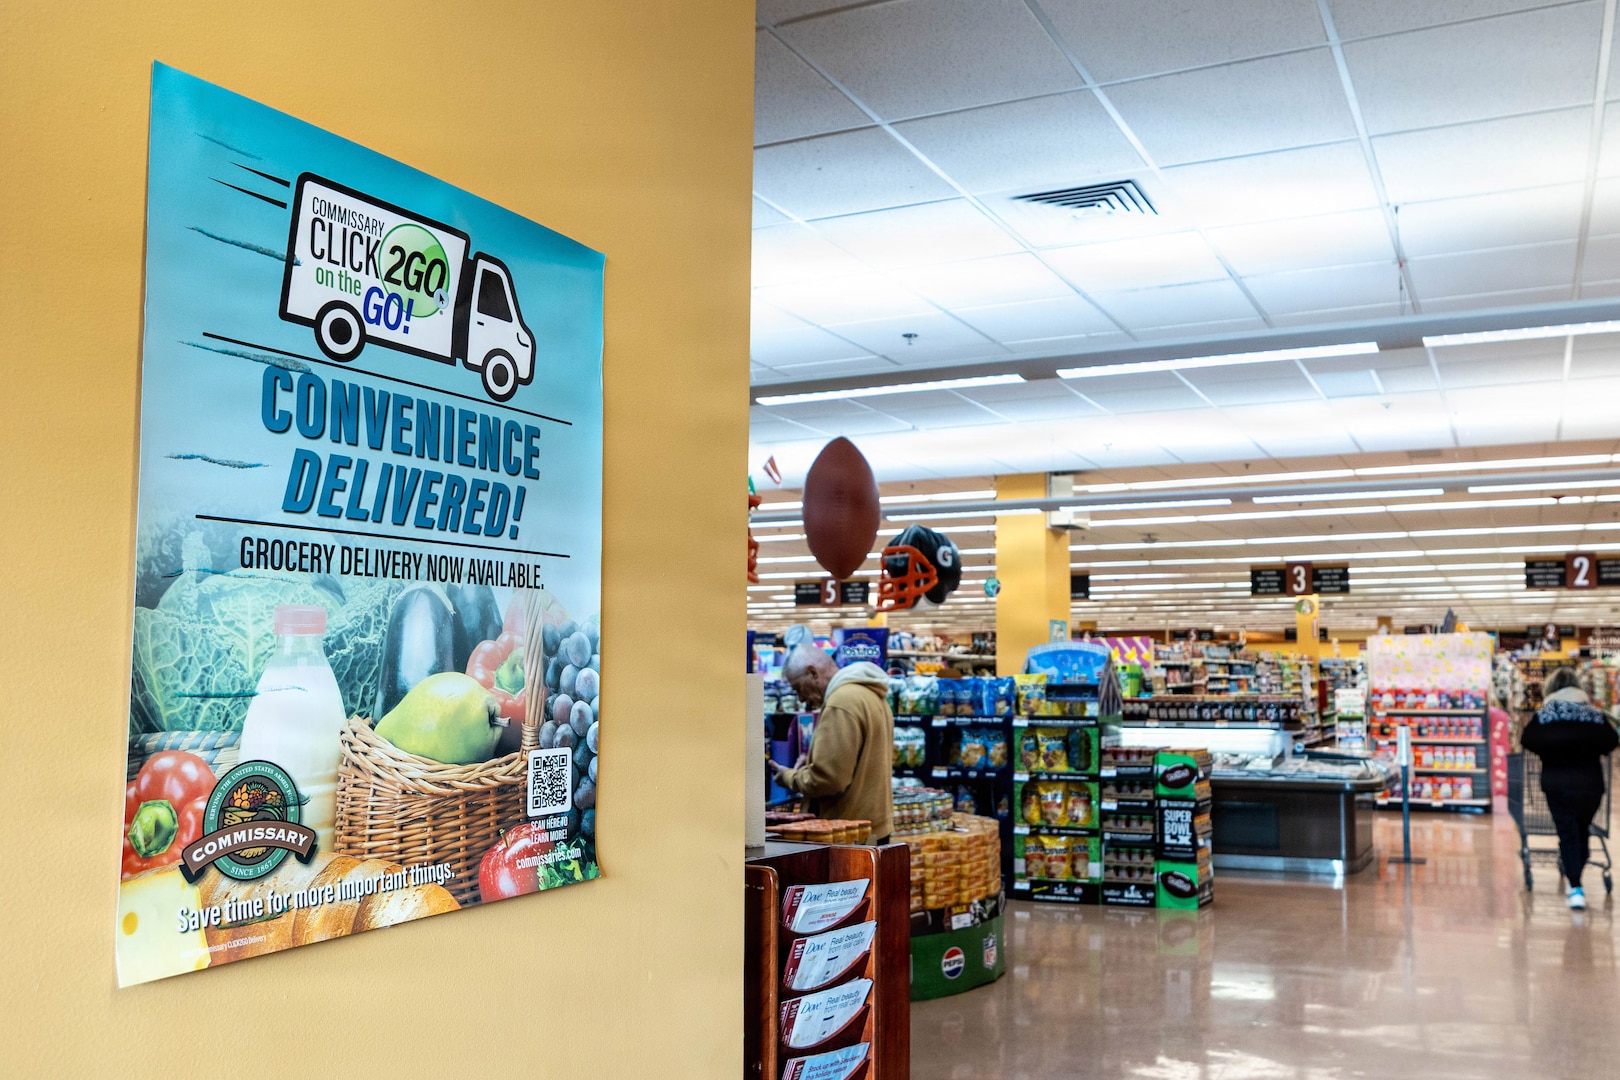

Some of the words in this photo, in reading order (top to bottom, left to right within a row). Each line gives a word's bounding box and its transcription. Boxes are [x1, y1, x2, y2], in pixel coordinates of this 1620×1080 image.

[312, 196, 385, 238] COMMISSARY
[310, 217, 381, 279] CLICK
[383, 245, 447, 298] 2GO
[315, 268, 335, 289] on
[338, 270, 362, 296] the
[363, 286, 414, 334] GO!
[261, 364, 541, 480] CONVENIENCE
[281, 447, 527, 540] DELIVERED!
[240, 536, 336, 574] GROCERY
[340, 545, 423, 581] DELIVERY
[426, 553, 464, 585] NOW
[467, 557, 545, 590] AVAILABLE.
[936, 545, 953, 567] G
[1292, 565, 1307, 592] 3
[1573, 556, 1590, 586] 2
[825, 580, 836, 604] 5
[210, 791, 223, 820] SERVING
[220, 778, 232, 791] THE
[231, 766, 254, 779] UNITED
[254, 765, 275, 775] STATES
[274, 772, 289, 791] ARMED
[530, 819, 546, 832] SCAN
[546, 817, 560, 829] HERE
[560, 815, 569, 827] TO
[1163, 809, 1192, 822] SUPER
[531, 831, 550, 844] LEARN
[549, 829, 568, 842] MORE!
[1163, 822, 1192, 835] BOWL
[1164, 835, 1192, 845] LX
[191, 828, 309, 862] COMMISSARY
[230, 866, 254, 876] SINCE
[257, 860, 273, 874] 1867
[515, 847, 582, 870] commissaries.com
[177, 906, 221, 933] Save
[223, 896, 264, 923] time
[266, 890, 291, 915] for
[293, 886, 335, 909] more
[337, 870, 408, 902] important
[409, 862, 456, 886] things.
[802, 891, 823, 904] Dove
[805, 942, 827, 955] Dove
[943, 958, 964, 968] PEPSI
[800, 1001, 822, 1015] Dove
